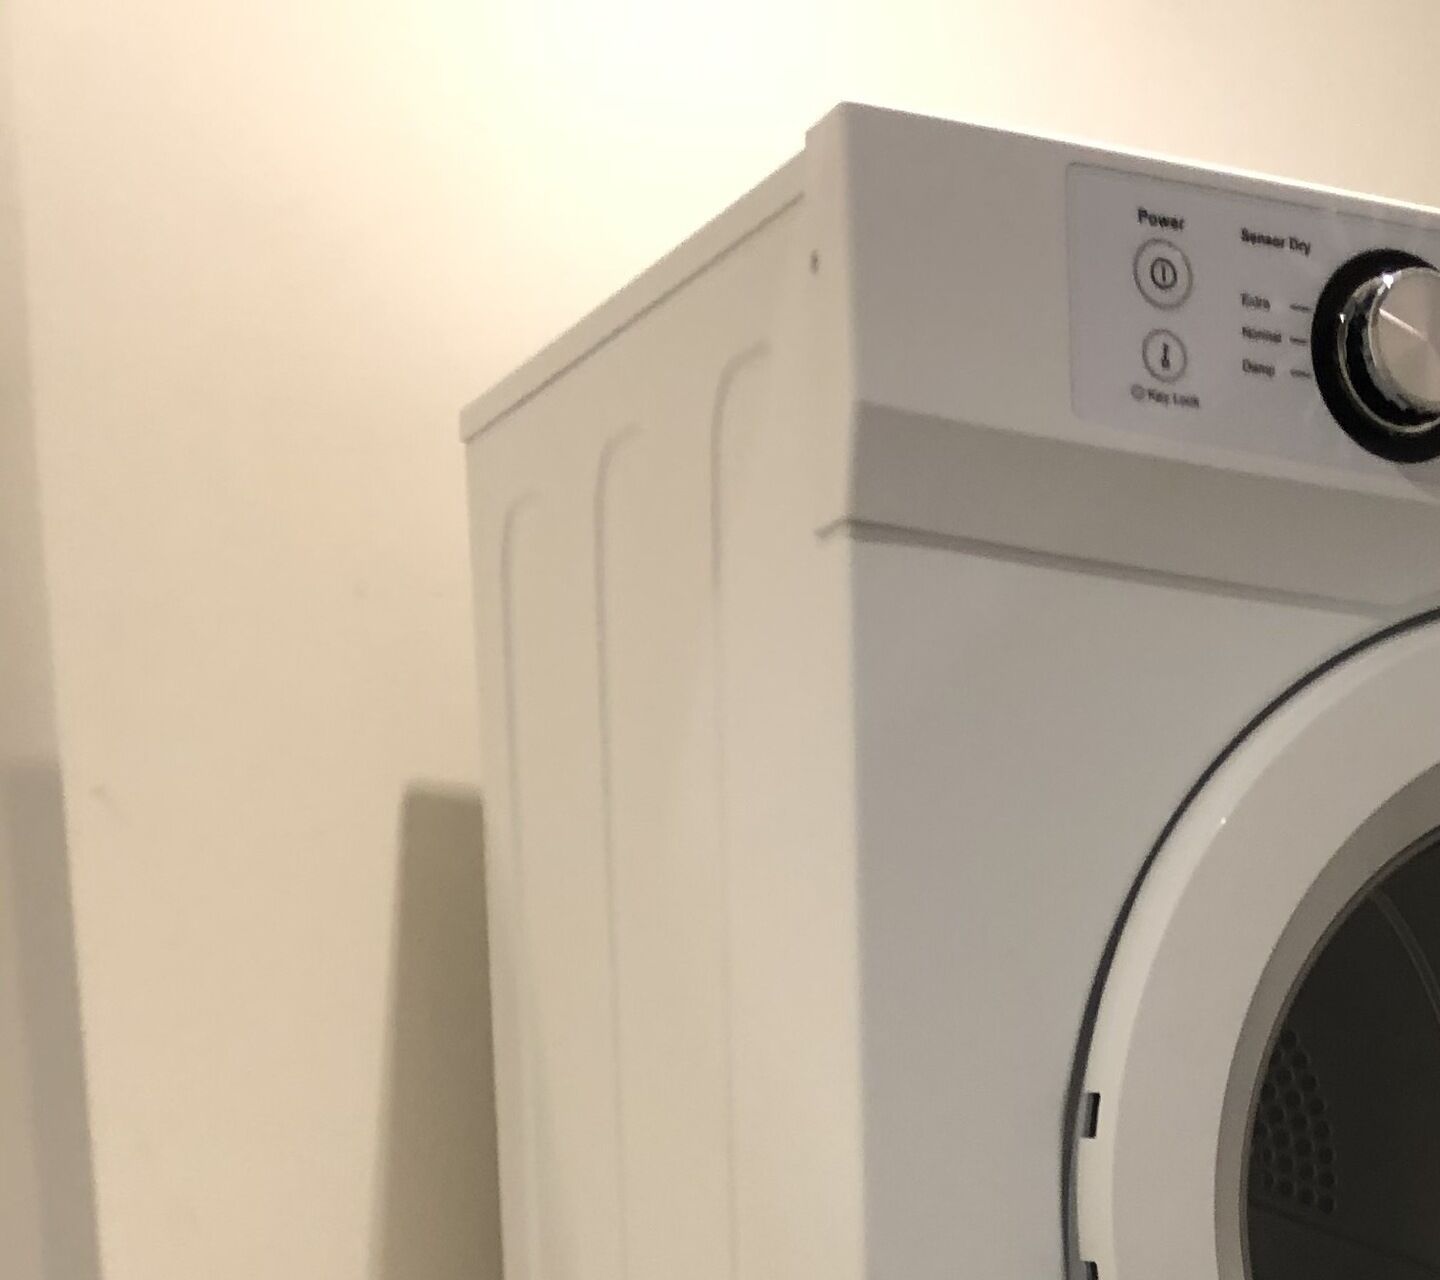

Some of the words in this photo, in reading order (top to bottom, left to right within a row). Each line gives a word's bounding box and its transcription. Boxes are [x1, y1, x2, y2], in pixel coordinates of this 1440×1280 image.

[1138, 207, 1184, 231] Power
[1241, 227, 1284, 248] Sensor
[1289, 236, 1311, 256] Dry
[1242, 326, 1282, 343] Normal
[1242, 359, 1275, 377] Damp
